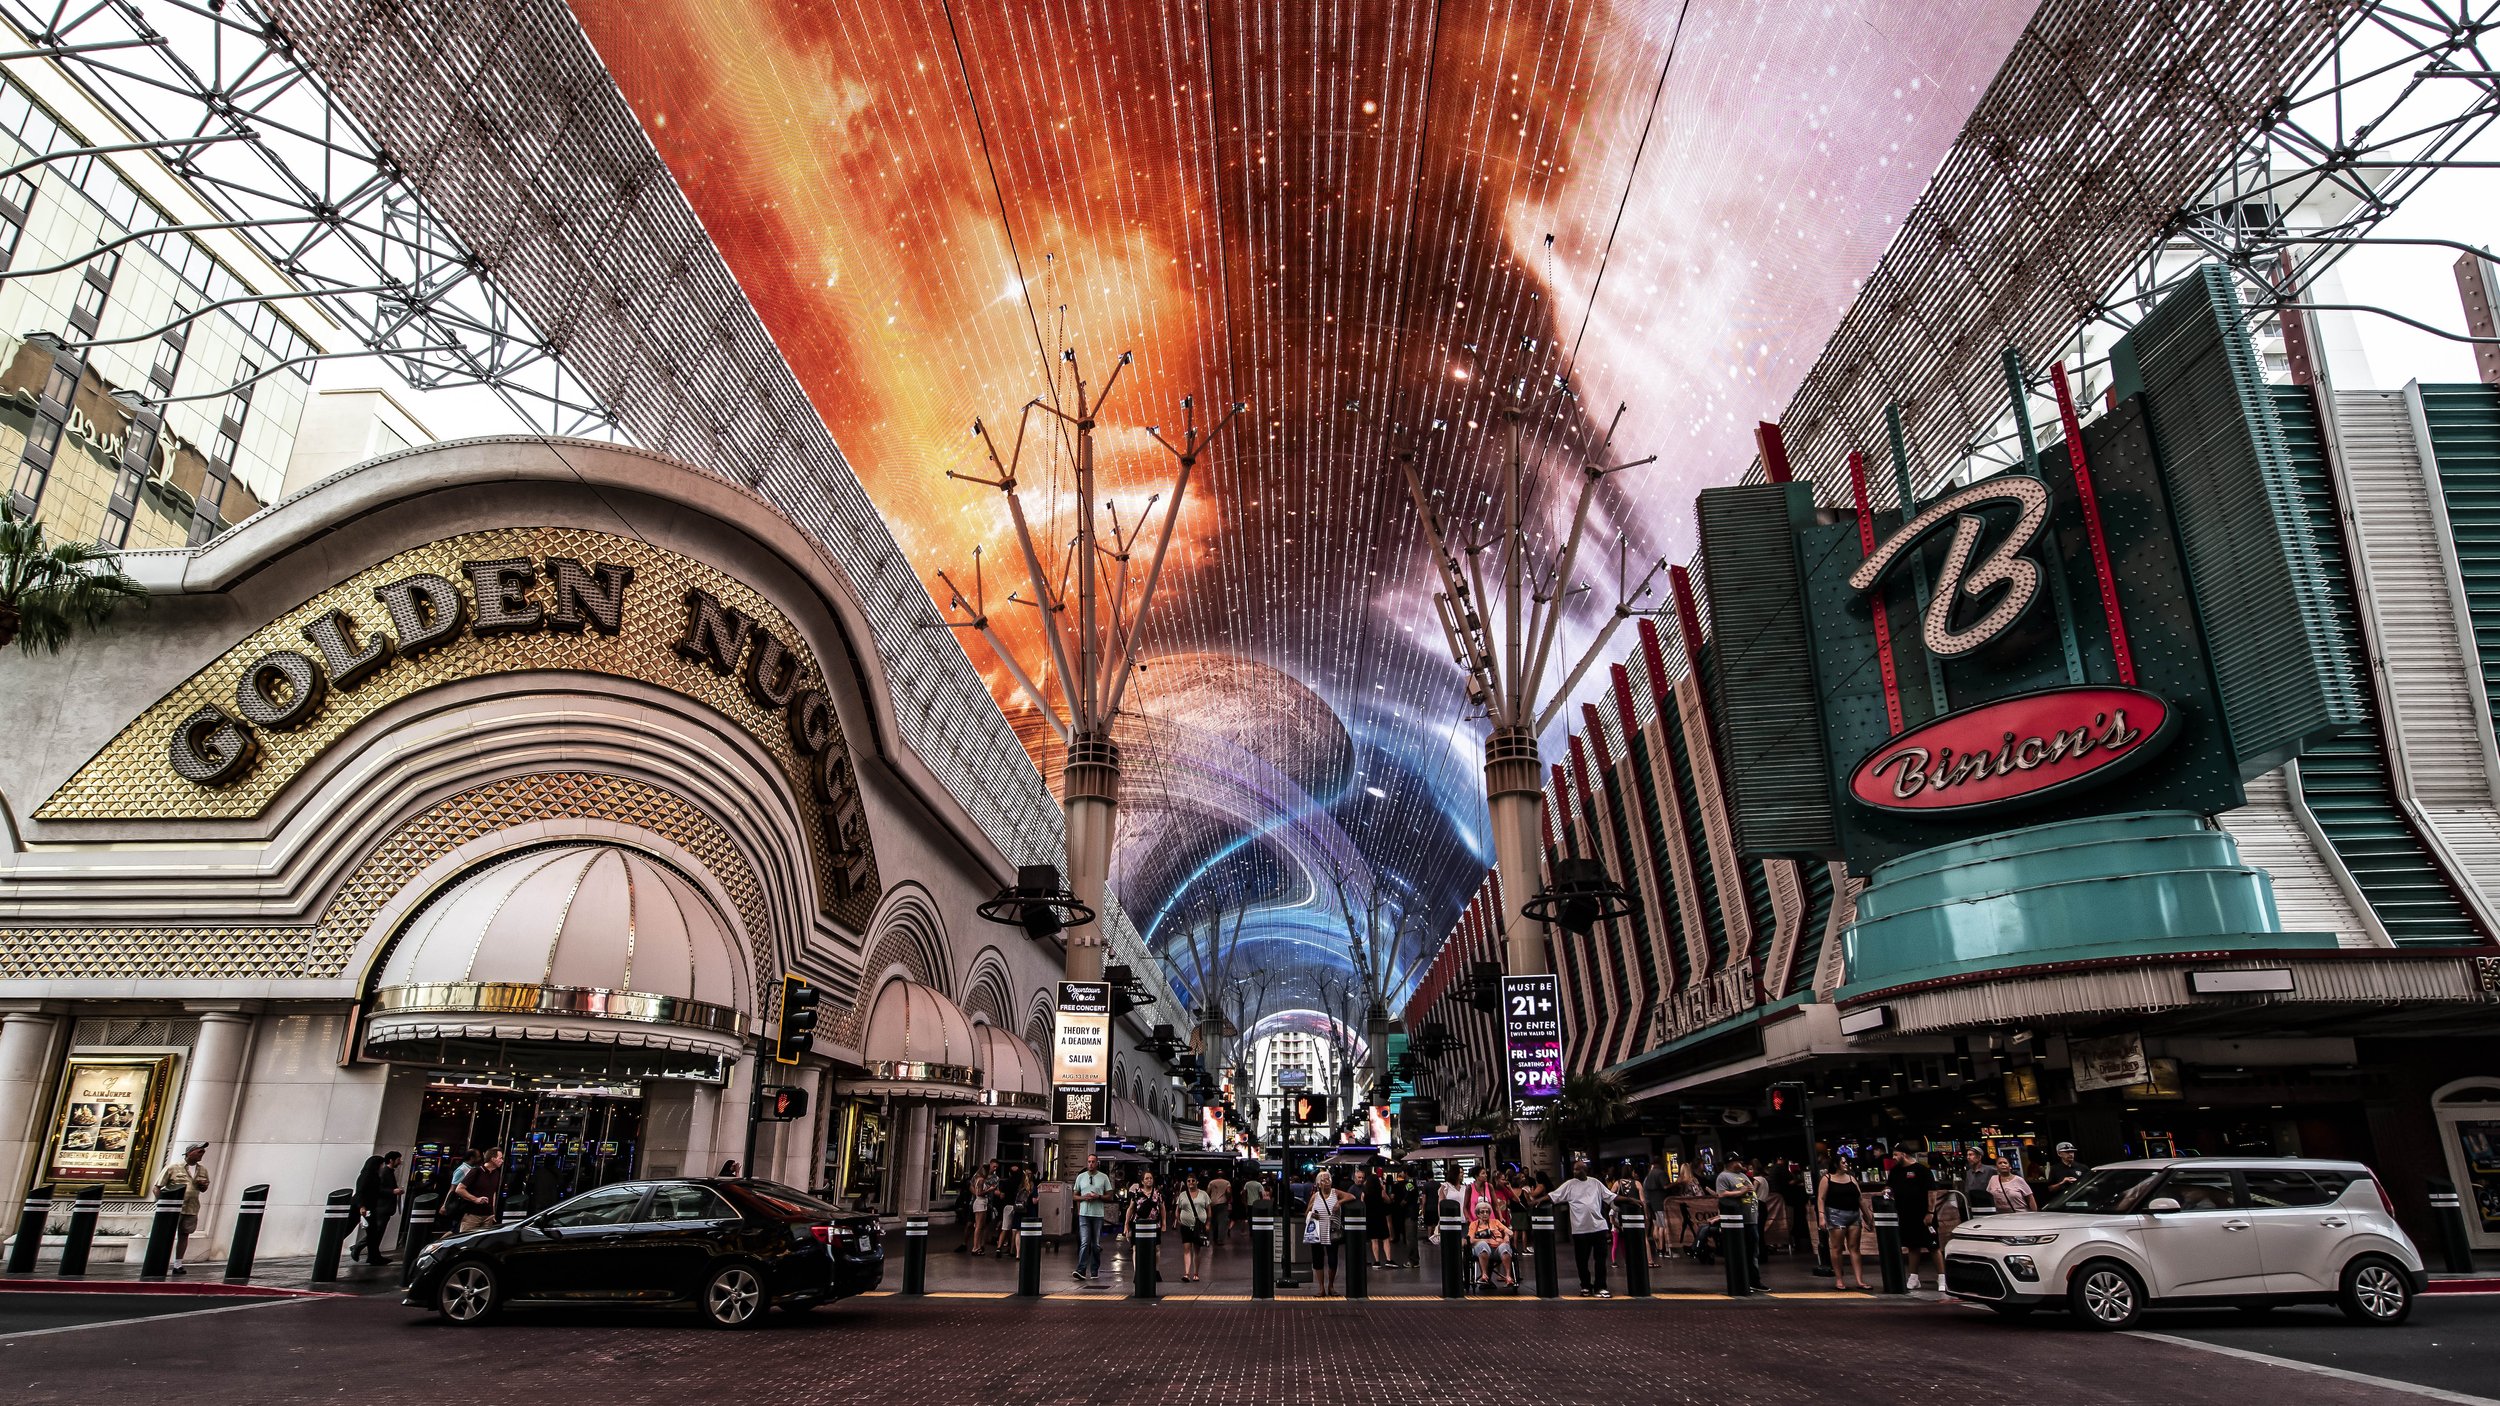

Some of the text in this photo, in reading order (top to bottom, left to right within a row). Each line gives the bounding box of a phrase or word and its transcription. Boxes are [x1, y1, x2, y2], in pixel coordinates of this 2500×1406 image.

[1850, 474, 2053, 660] B
[168, 556, 868, 899] GOLDEN NUGGET
[1872, 708, 2140, 798] Binion's
[1066, 984, 1101, 993] Downtown
[1508, 983, 1552, 991] MUST BE
[1511, 996, 1552, 1015] 21+
[1653, 956, 1756, 1050] GAMBLING
[1076, 1004, 1106, 1012] CONCERT
[1510, 1021, 1556, 1030] TO ENTER
[1064, 1027, 1101, 1035] THEORY OF
[1061, 1037, 1102, 1045] A DEADMAN
[1511, 1050, 1527, 1059] FRI
[1535, 1049, 1558, 1058] SUN
[1068, 1055, 1093, 1063] SALIVA
